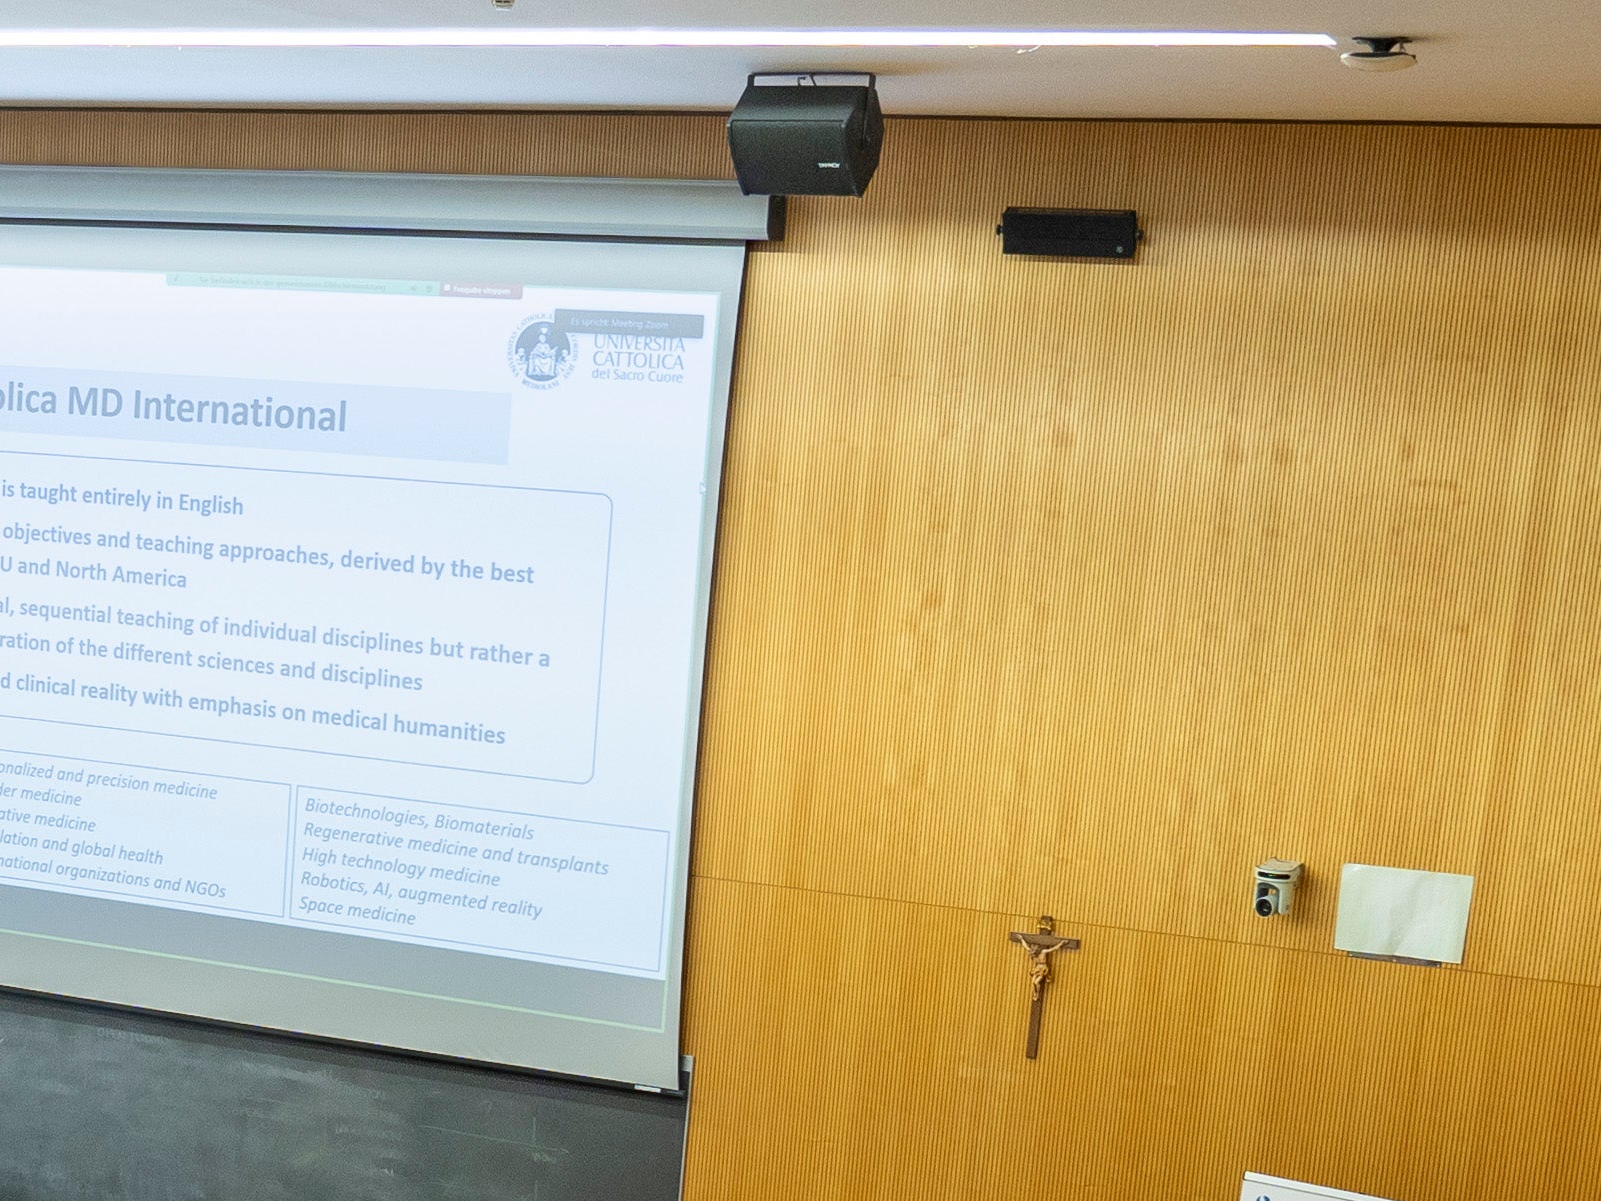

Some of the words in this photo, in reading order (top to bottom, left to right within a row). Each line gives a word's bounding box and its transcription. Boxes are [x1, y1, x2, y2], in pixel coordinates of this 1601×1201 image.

[591, 369, 610, 380] del
[613, 370, 645, 382] Sacro
[649, 371, 683, 384] Cuore
[593, 350, 684, 370] CATTOLICA
[68, 386, 122, 417] MD
[133, 389, 346, 431] International
[2, 479, 14, 497] is
[19, 482, 77, 504] taught
[82, 487, 151, 511] entirely
[156, 490, 172, 509] in
[179, 493, 243, 516] English
[2, 522, 91, 545] objectives
[96, 530, 130, 548] and
[135, 533, 214, 560] teaching
[219, 543, 334, 569] approaches,
[340, 549, 414, 573] derived
[421, 555, 445, 580] by
[450, 558, 483, 579] the
[490, 561, 534, 583] best
[17, 558, 50, 575] and
[56, 560, 106, 580] North
[111, 565, 186, 587] America
[19, 602, 111, 623] sequential
[116, 608, 194, 635] teaching
[199, 615, 219, 633] of
[224, 616, 316, 643] individual
[322, 627, 423, 654] disciplines
[429, 636, 464, 658] but
[469, 643, 533, 665] rather
[538, 653, 549, 667] a
[55, 636, 74, 654] of
[78, 638, 107, 657] the
[113, 641, 192, 666] different
[197, 651, 274, 674] sciences
[280, 661, 315, 679] and
[321, 663, 422, 690] disciplines
[16, 673, 75, 696] clinical
[81, 682, 137, 706] reality
[142, 688, 182, 707] with
[188, 695, 275, 718] emphasis
[281, 707, 305, 721] on
[312, 708, 386, 730] medical
[393, 713, 504, 744] humanities
[20, 788, 82, 806] medicine
[57, 769, 83, 782] and
[86, 773, 148, 791] precision
[153, 781, 217, 799] medicine
[34, 814, 95, 832] medicine
[304, 797, 428, 828] Biotechnologies,
[434, 814, 533, 839] Biomaterials
[41, 837, 69, 851] and
[71, 839, 116, 857] global
[118, 845, 163, 864] health
[302, 847, 336, 866] High
[341, 852, 426, 879] technology
[429, 866, 500, 886] medicine
[303, 822, 403, 848] Regenerative
[407, 838, 477, 857] medicine
[481, 847, 513, 862] and
[517, 850, 608, 875] transplants
[55, 864, 149, 887] organizations
[153, 877, 181, 891] and
[184, 879, 225, 897] NGOs
[300, 870, 367, 895] Robotics,
[372, 881, 392, 899] AI,
[398, 887, 488, 909] augmented
[491, 899, 542, 920] reality
[300, 895, 343, 915] Space
[347, 905, 415, 925] medicine
